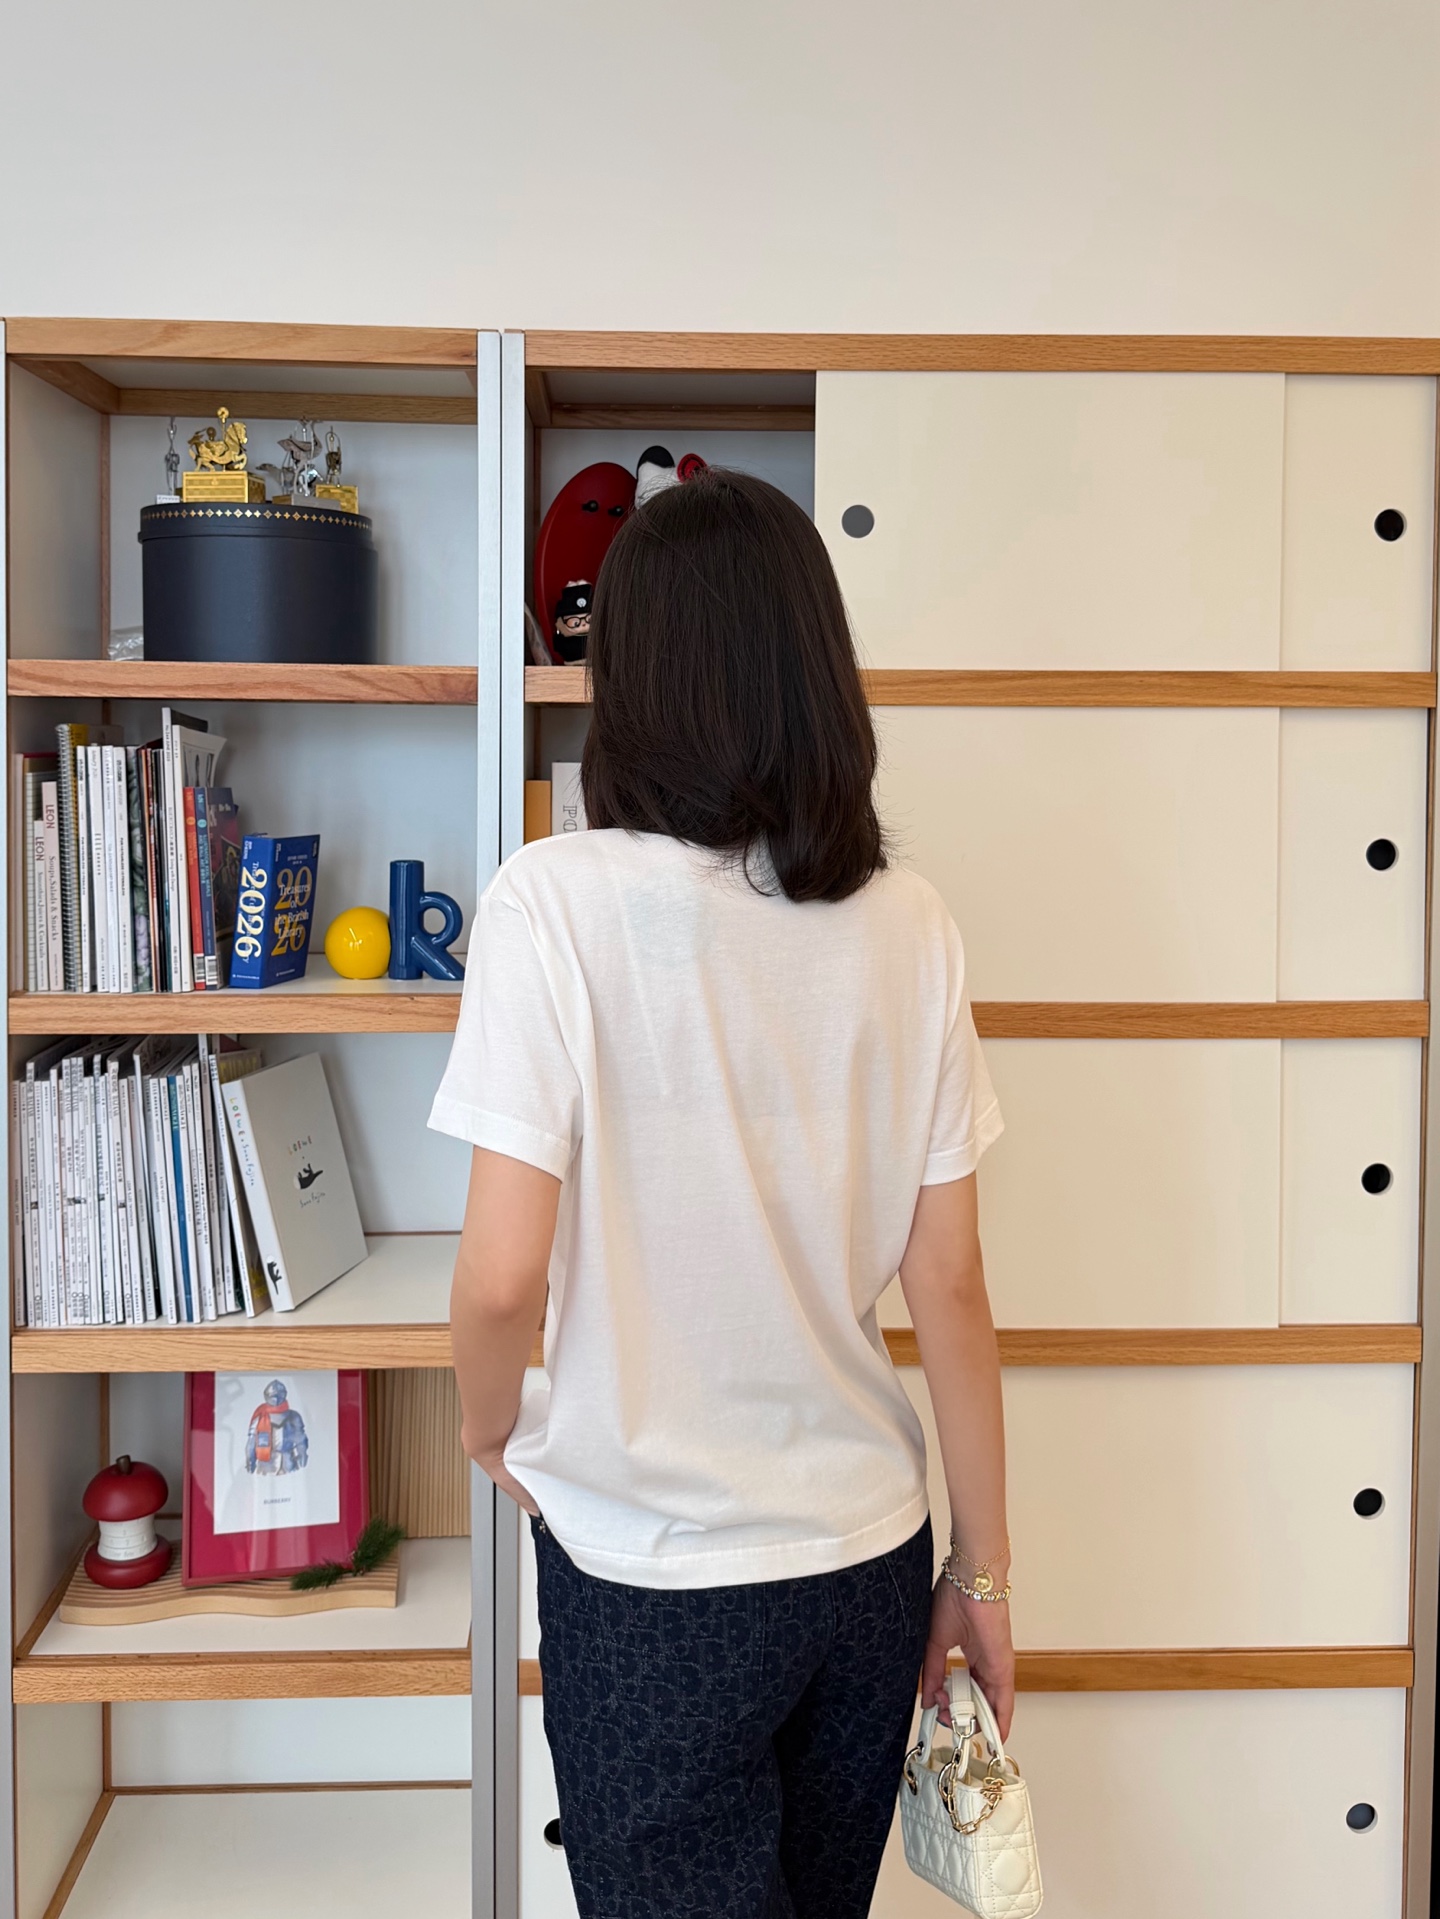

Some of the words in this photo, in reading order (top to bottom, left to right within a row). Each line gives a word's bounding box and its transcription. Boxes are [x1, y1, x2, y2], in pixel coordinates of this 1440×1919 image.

[36, 837, 44, 861] LEON
[46, 805, 55, 829] LEON
[51, 914, 59, 940] Snacks
[274, 866, 312, 910] 20
[280, 884, 310, 896] Treasures
[235, 866, 267, 958] 2026
[288, 909, 309, 923] British
[270, 912, 306, 956] 26
[230, 1097, 245, 1135] LOEWE
